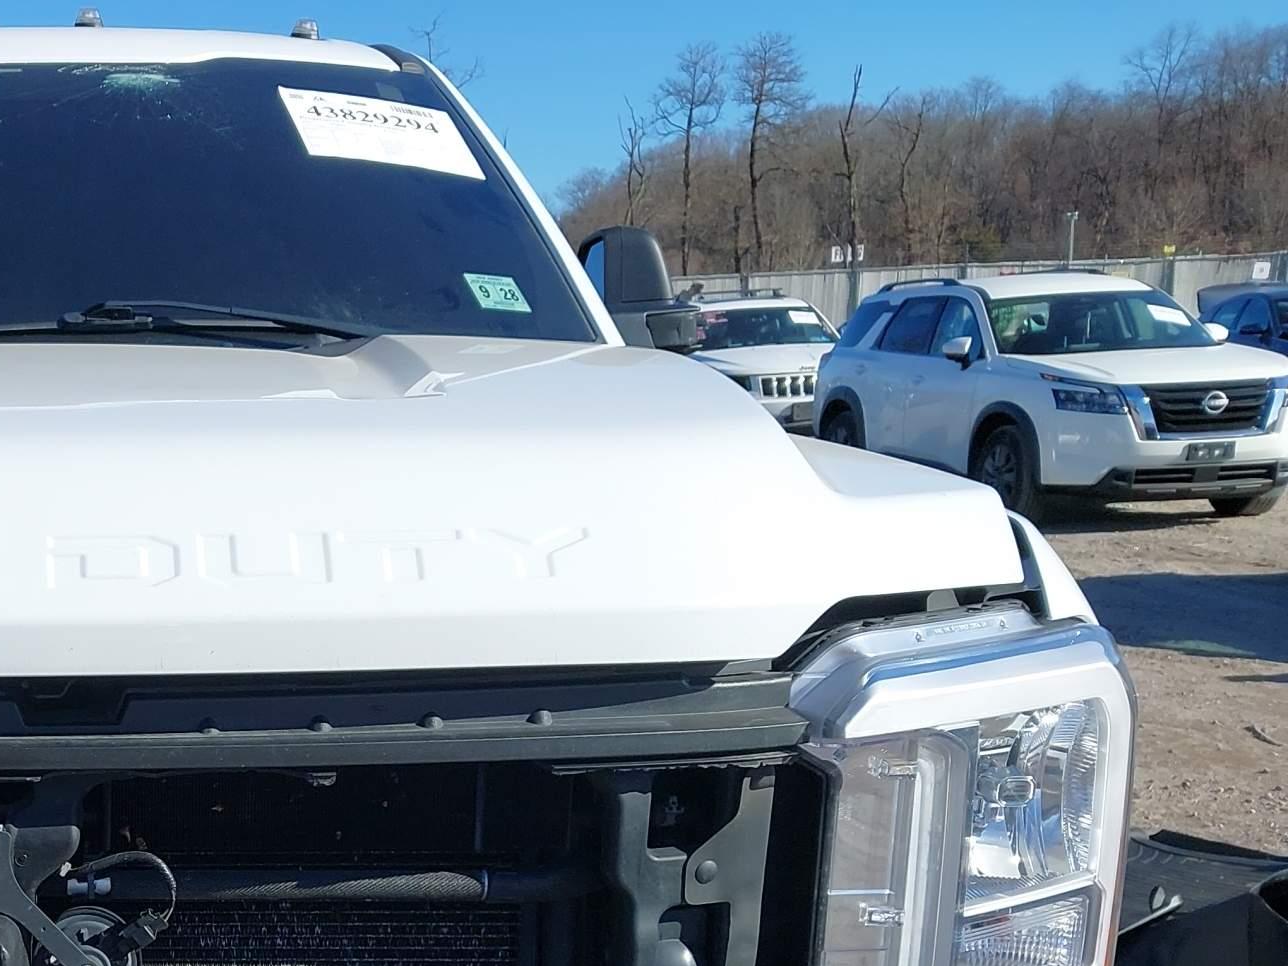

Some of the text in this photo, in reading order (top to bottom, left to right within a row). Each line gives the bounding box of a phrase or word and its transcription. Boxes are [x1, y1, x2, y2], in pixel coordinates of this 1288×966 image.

[306, 104, 440, 134] 43829294
[478, 284, 520, 302] 9 28
[44, 525, 591, 591] DUTY
